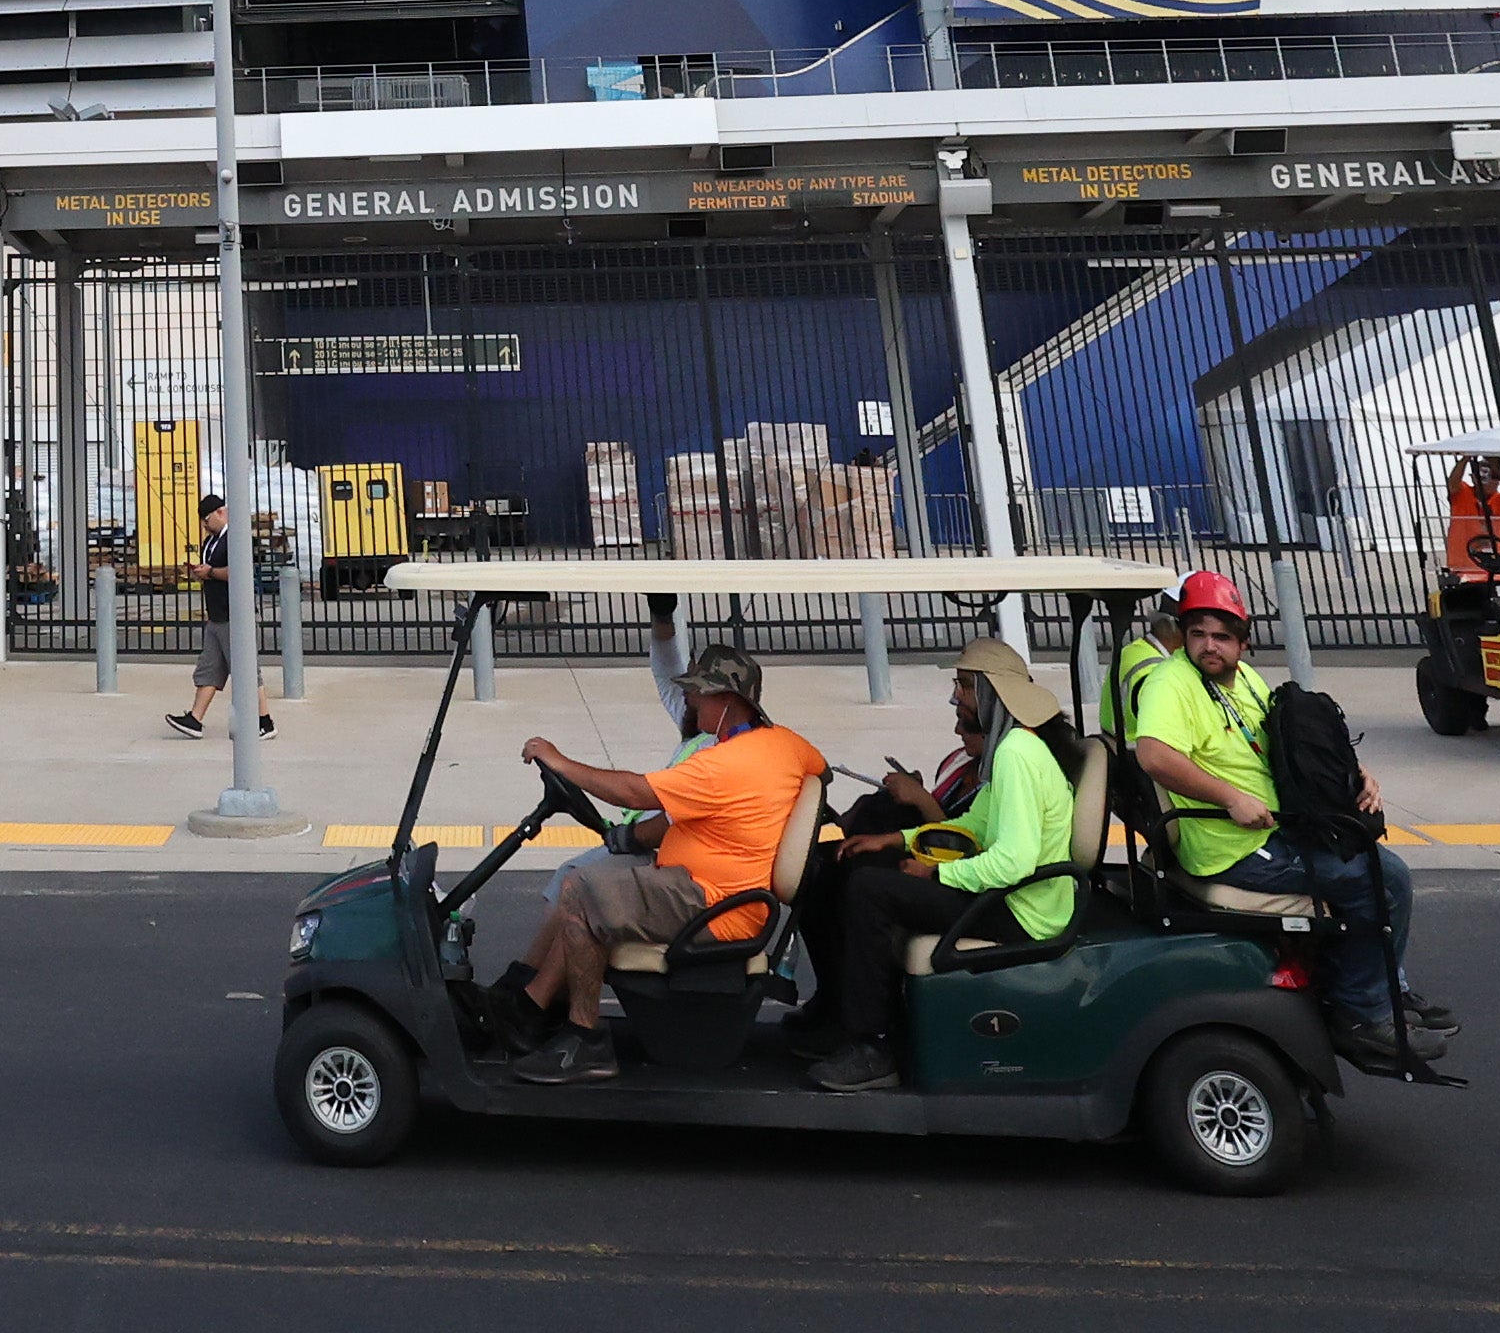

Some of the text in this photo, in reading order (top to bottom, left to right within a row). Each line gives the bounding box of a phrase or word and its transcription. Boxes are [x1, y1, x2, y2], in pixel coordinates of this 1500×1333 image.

[1023, 163, 1192, 184] METAL DETECTORS
[1270, 159, 1435, 189] GENERAL
[693, 175, 907, 193] NO WEAPONS OF ANY TYPE ARE
[1080, 181, 1140, 199] IN USE
[56, 192, 211, 211] METAL DETECTORS
[283, 182, 640, 217] GENERAL ADMISSION
[688, 190, 916, 210] PERMITTED AT STADIUM
[107, 210, 161, 226] IN USE
[148, 385, 164, 393] ALL
[990, 1016, 1000, 1033] 1
